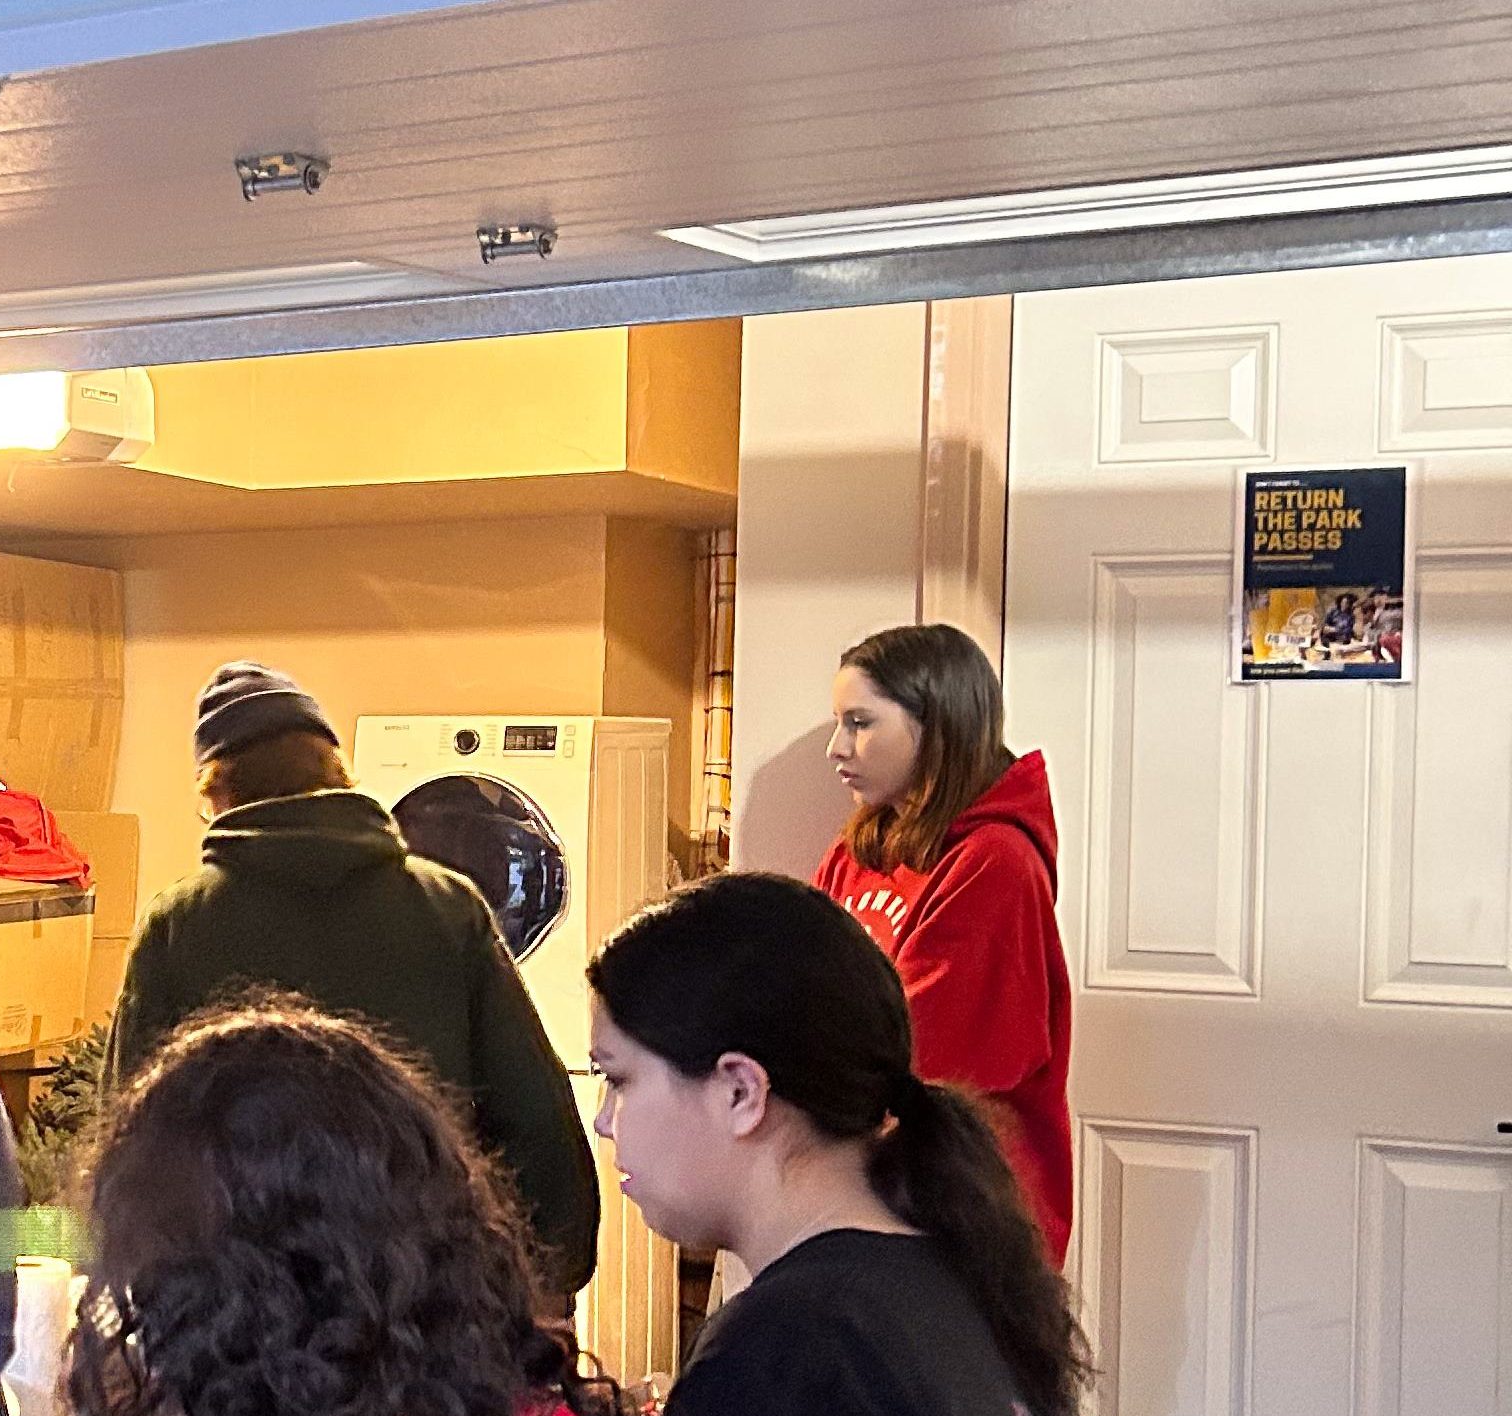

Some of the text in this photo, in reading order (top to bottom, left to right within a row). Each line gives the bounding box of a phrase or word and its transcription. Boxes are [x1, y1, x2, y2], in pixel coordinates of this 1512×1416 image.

[1255, 489, 1344, 510] RETURN
[1254, 509, 1362, 531] THE PARK
[1254, 530, 1343, 551] PASSES
